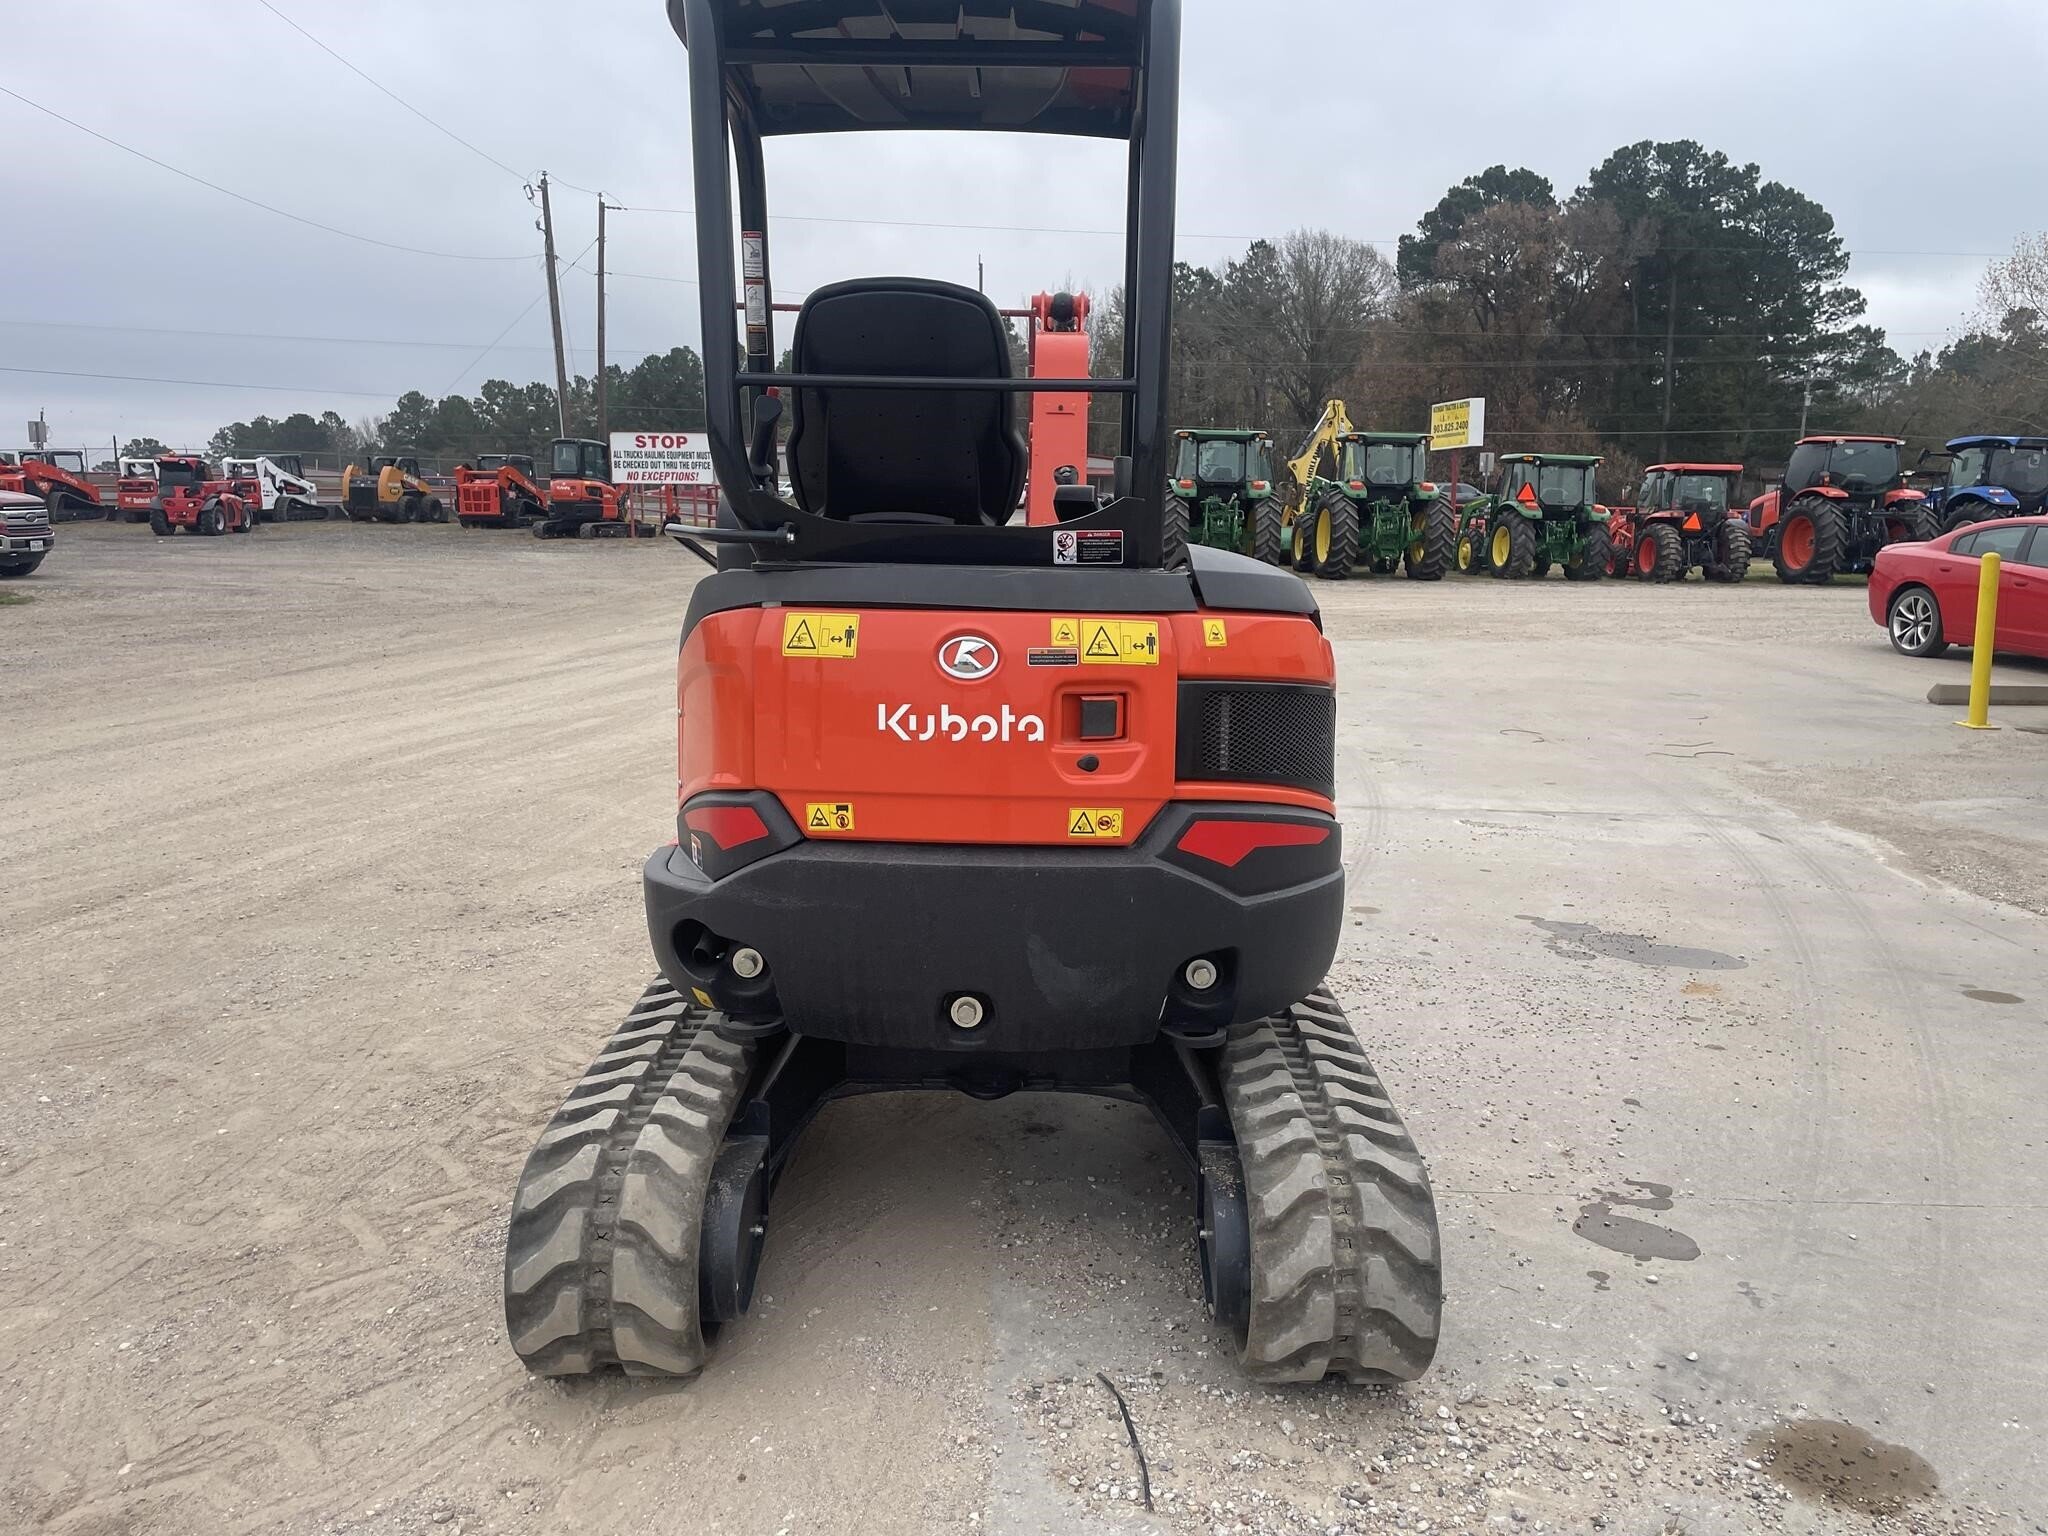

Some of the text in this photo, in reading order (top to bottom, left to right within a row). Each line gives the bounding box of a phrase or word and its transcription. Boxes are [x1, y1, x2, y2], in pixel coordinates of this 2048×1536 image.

[1433, 420, 1468, 434] 903.825.2400
[635, 435, 688, 449] STOP
[613, 451, 711, 460] ALL TRUCKS HAULING EQUIPMENT MUST
[613, 460, 711, 470] BE CHECKED OUT THRU THE OFFICE
[627, 471, 699, 481] NO EXCEPTIONS!
[878, 703, 1045, 742] Kubota
